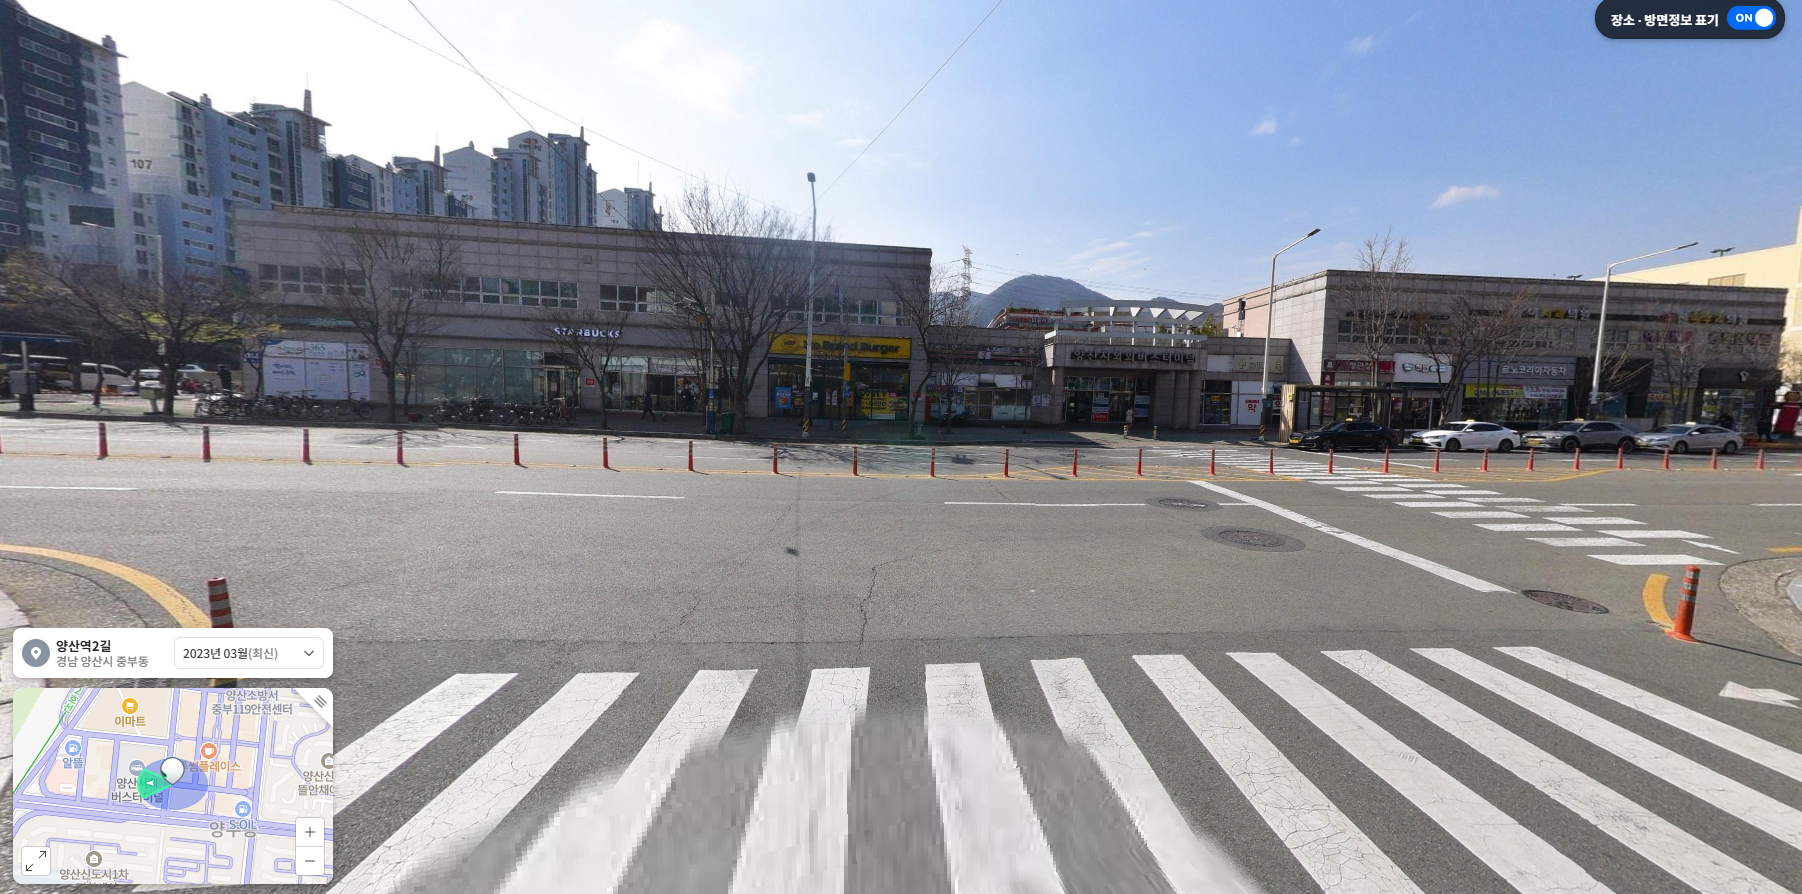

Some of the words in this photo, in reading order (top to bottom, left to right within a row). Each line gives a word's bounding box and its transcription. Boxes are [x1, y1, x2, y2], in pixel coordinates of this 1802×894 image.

[131, 159, 152, 169] 107
[554, 327, 621, 339] STARBUCKS
[861, 342, 900, 355] Burger
[1502, 365, 1567, 376] 르노코리아자동차
[1247, 403, 1257, 413] 약
